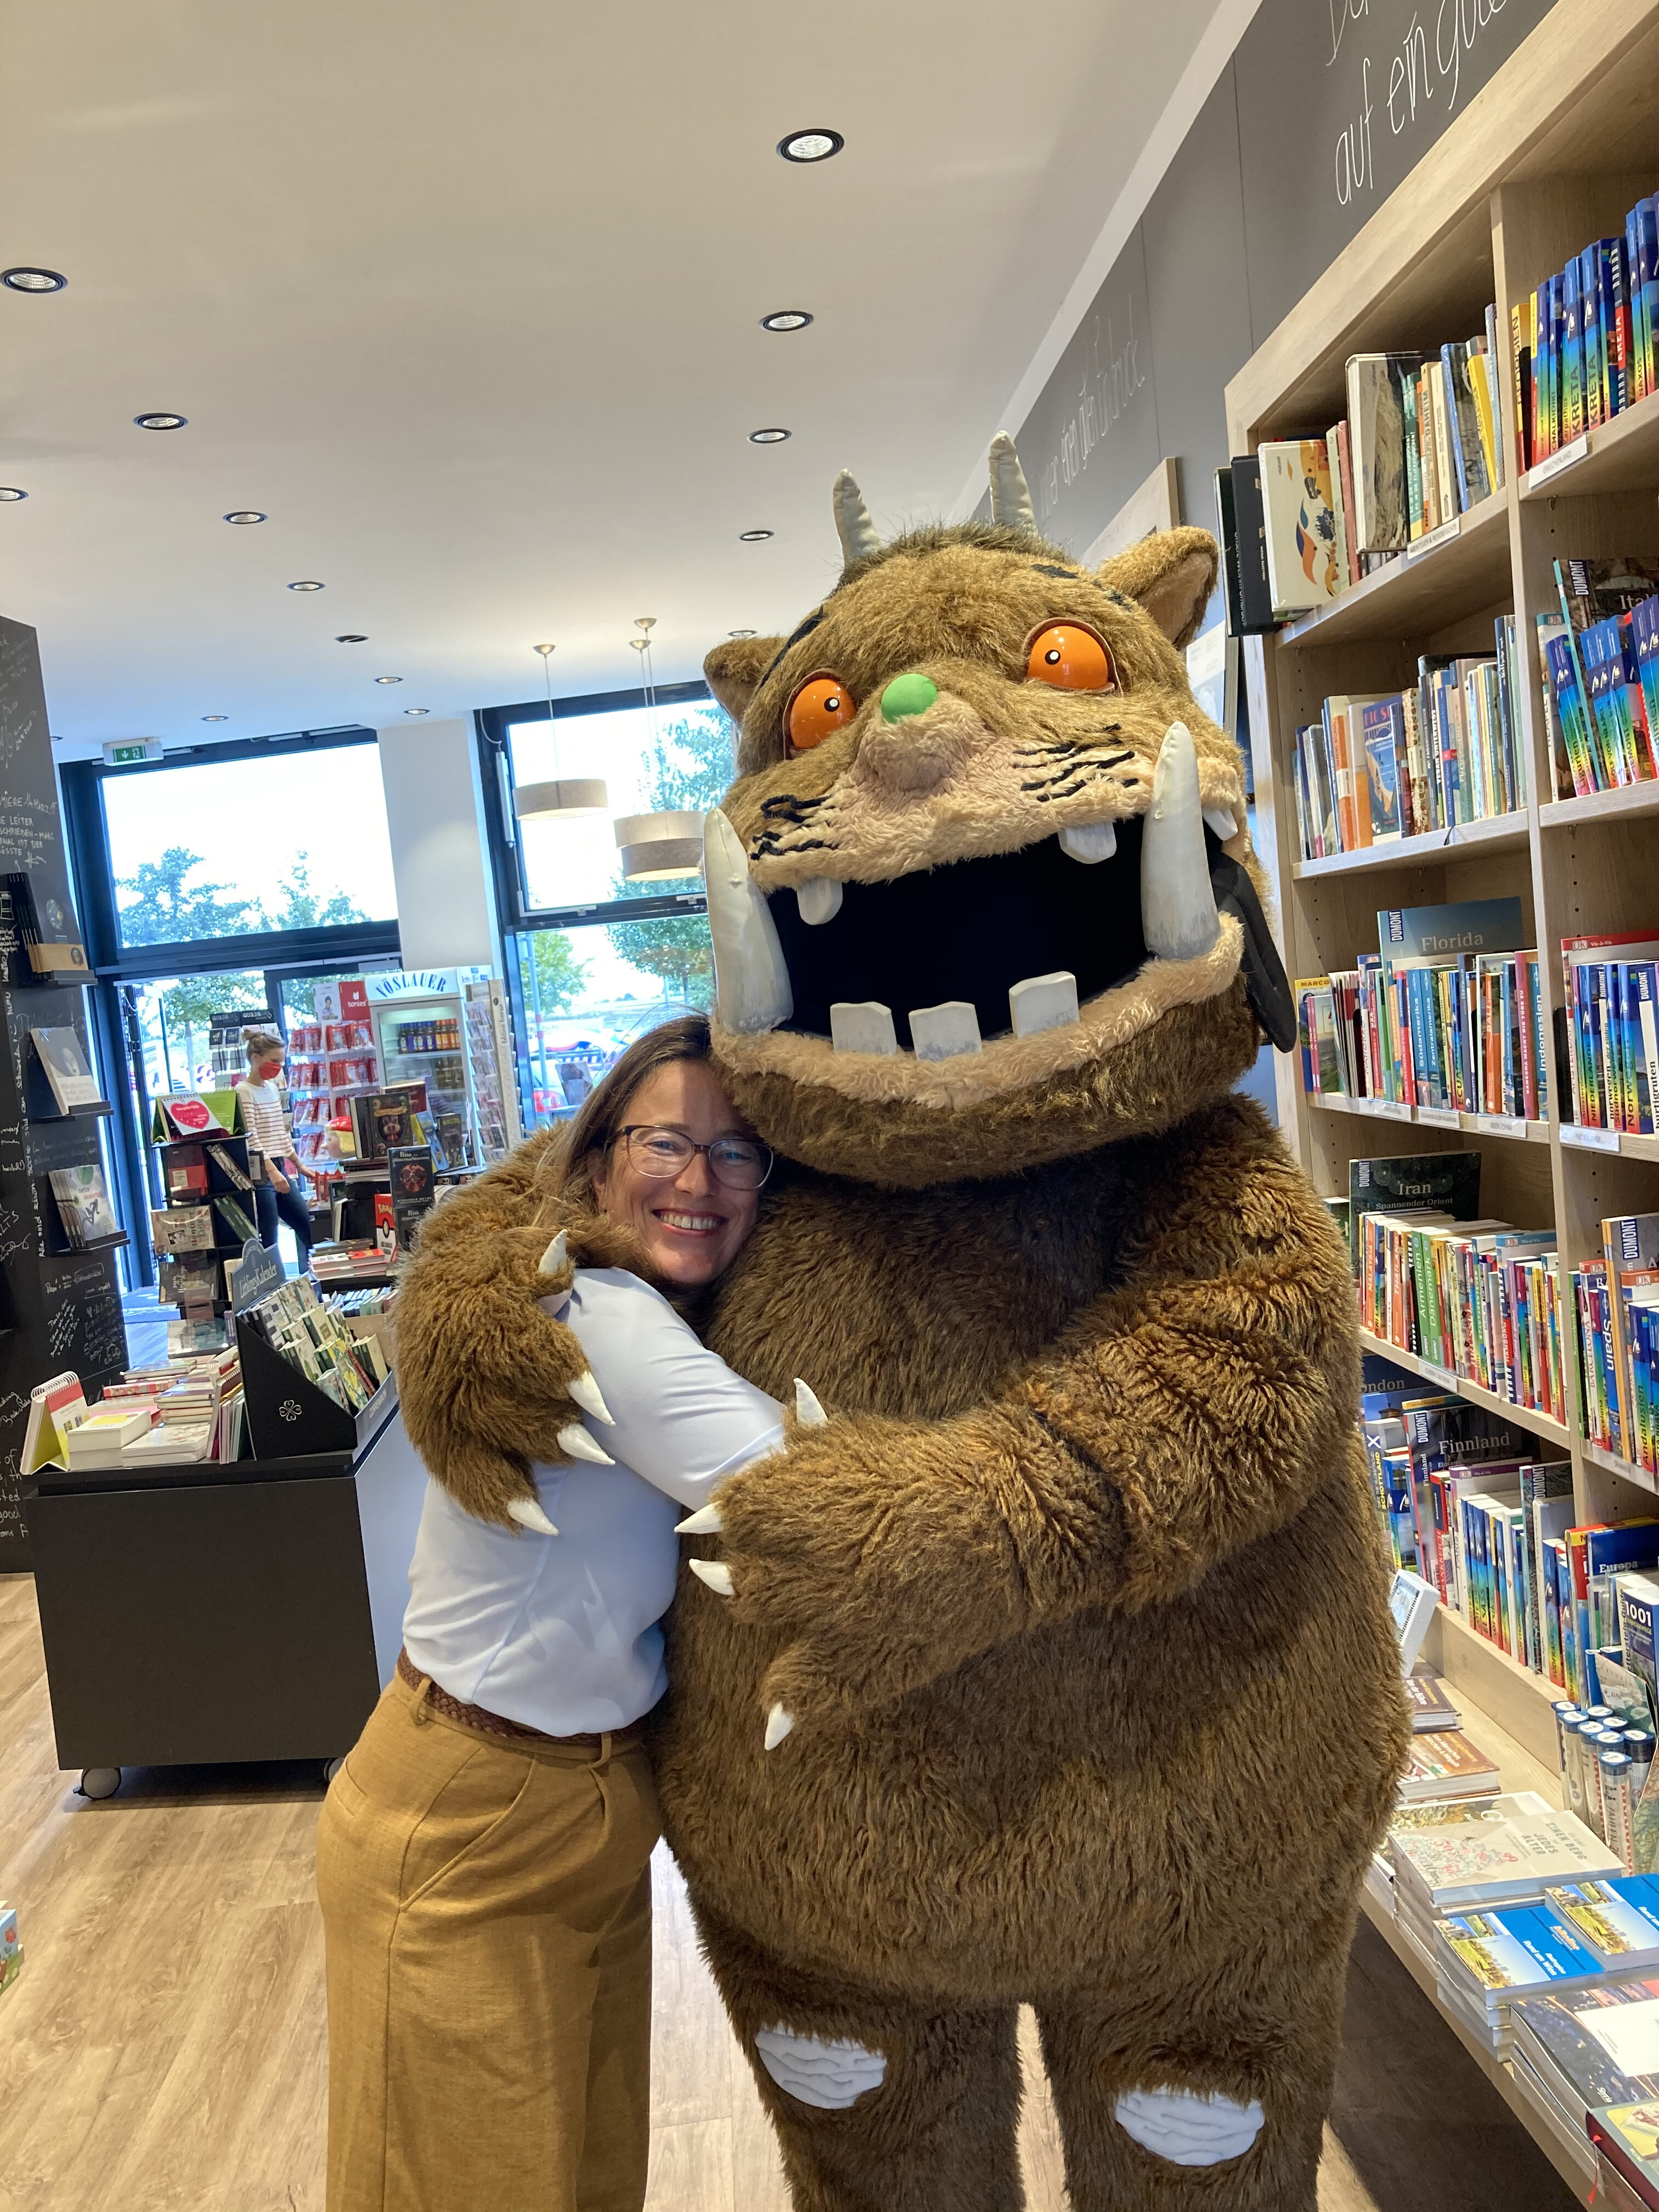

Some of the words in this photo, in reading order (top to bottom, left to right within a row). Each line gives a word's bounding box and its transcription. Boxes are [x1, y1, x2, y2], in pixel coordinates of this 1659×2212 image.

[1335, 57, 1373, 205] auf
[1570, 365, 1581, 436] KRETA
[1588, 353, 1599, 426] KRETA
[1569, 560, 1589, 595] DUMONT
[1608, 760, 1617, 782] GOLF
[1388, 910, 1403, 943] DUMONT
[1421, 932, 1483, 952] Florida
[1572, 940, 1588, 950] DK
[376, 972, 447, 998] VÖSLAUER
[1301, 979, 1329, 988] MARCO
[1638, 971, 1649, 1000] DUMONT
[1414, 997, 1425, 1068] Südamerika
[1536, 995, 1547, 1071] Indonesien
[1623, 1039, 1635, 1126] Norwegen
[1359, 1161, 1370, 1187] DUMONT
[1375, 1200, 1425, 1211] Spannender
[1426, 1197, 1453, 1206] Orient
[1398, 1183, 1432, 1196] Iran
[1505, 1238, 1519, 1247] DK
[1621, 1220, 1639, 1259] DUMONT
[1590, 1263, 1604, 1273] DK
[1636, 1276, 1651, 1285] DK
[1416, 1252, 1427, 1319] Armenien
[1424, 1255, 1436, 1327] Dänemark
[1584, 1320, 1596, 1387] BARCELONA
[1602, 1318, 1615, 1370] Spain
[1360, 1378, 1405, 1393] ondon
[1417, 1413, 1428, 1443] DUMONT
[1636, 1385, 1650, 1466] Andalusien
[1437, 1431, 1511, 1455] Finnland
[1375, 1451, 1387, 1510] SCHOTTLAND
[1420, 1453, 1430, 1487] Finnland
[1459, 1470, 1472, 1480] DK
[1436, 1531, 1446, 1597] FRANKREICH
[1599, 1561, 1638, 1573] Europa
[1624, 1601, 1652, 1628] 1001
[1521, 1835, 1547, 1856] ALTER
[1534, 1833, 1559, 1855] JEDES
[1546, 1822, 1569, 1847] EINEN
[1566, 1842, 1588, 1860] BERG
[1638, 1906, 1656, 1919] Rund
[1522, 1940, 1540, 1954] Rund
[1534, 1953, 1546, 1962] um
[1542, 1960, 1558, 1976] Wien
